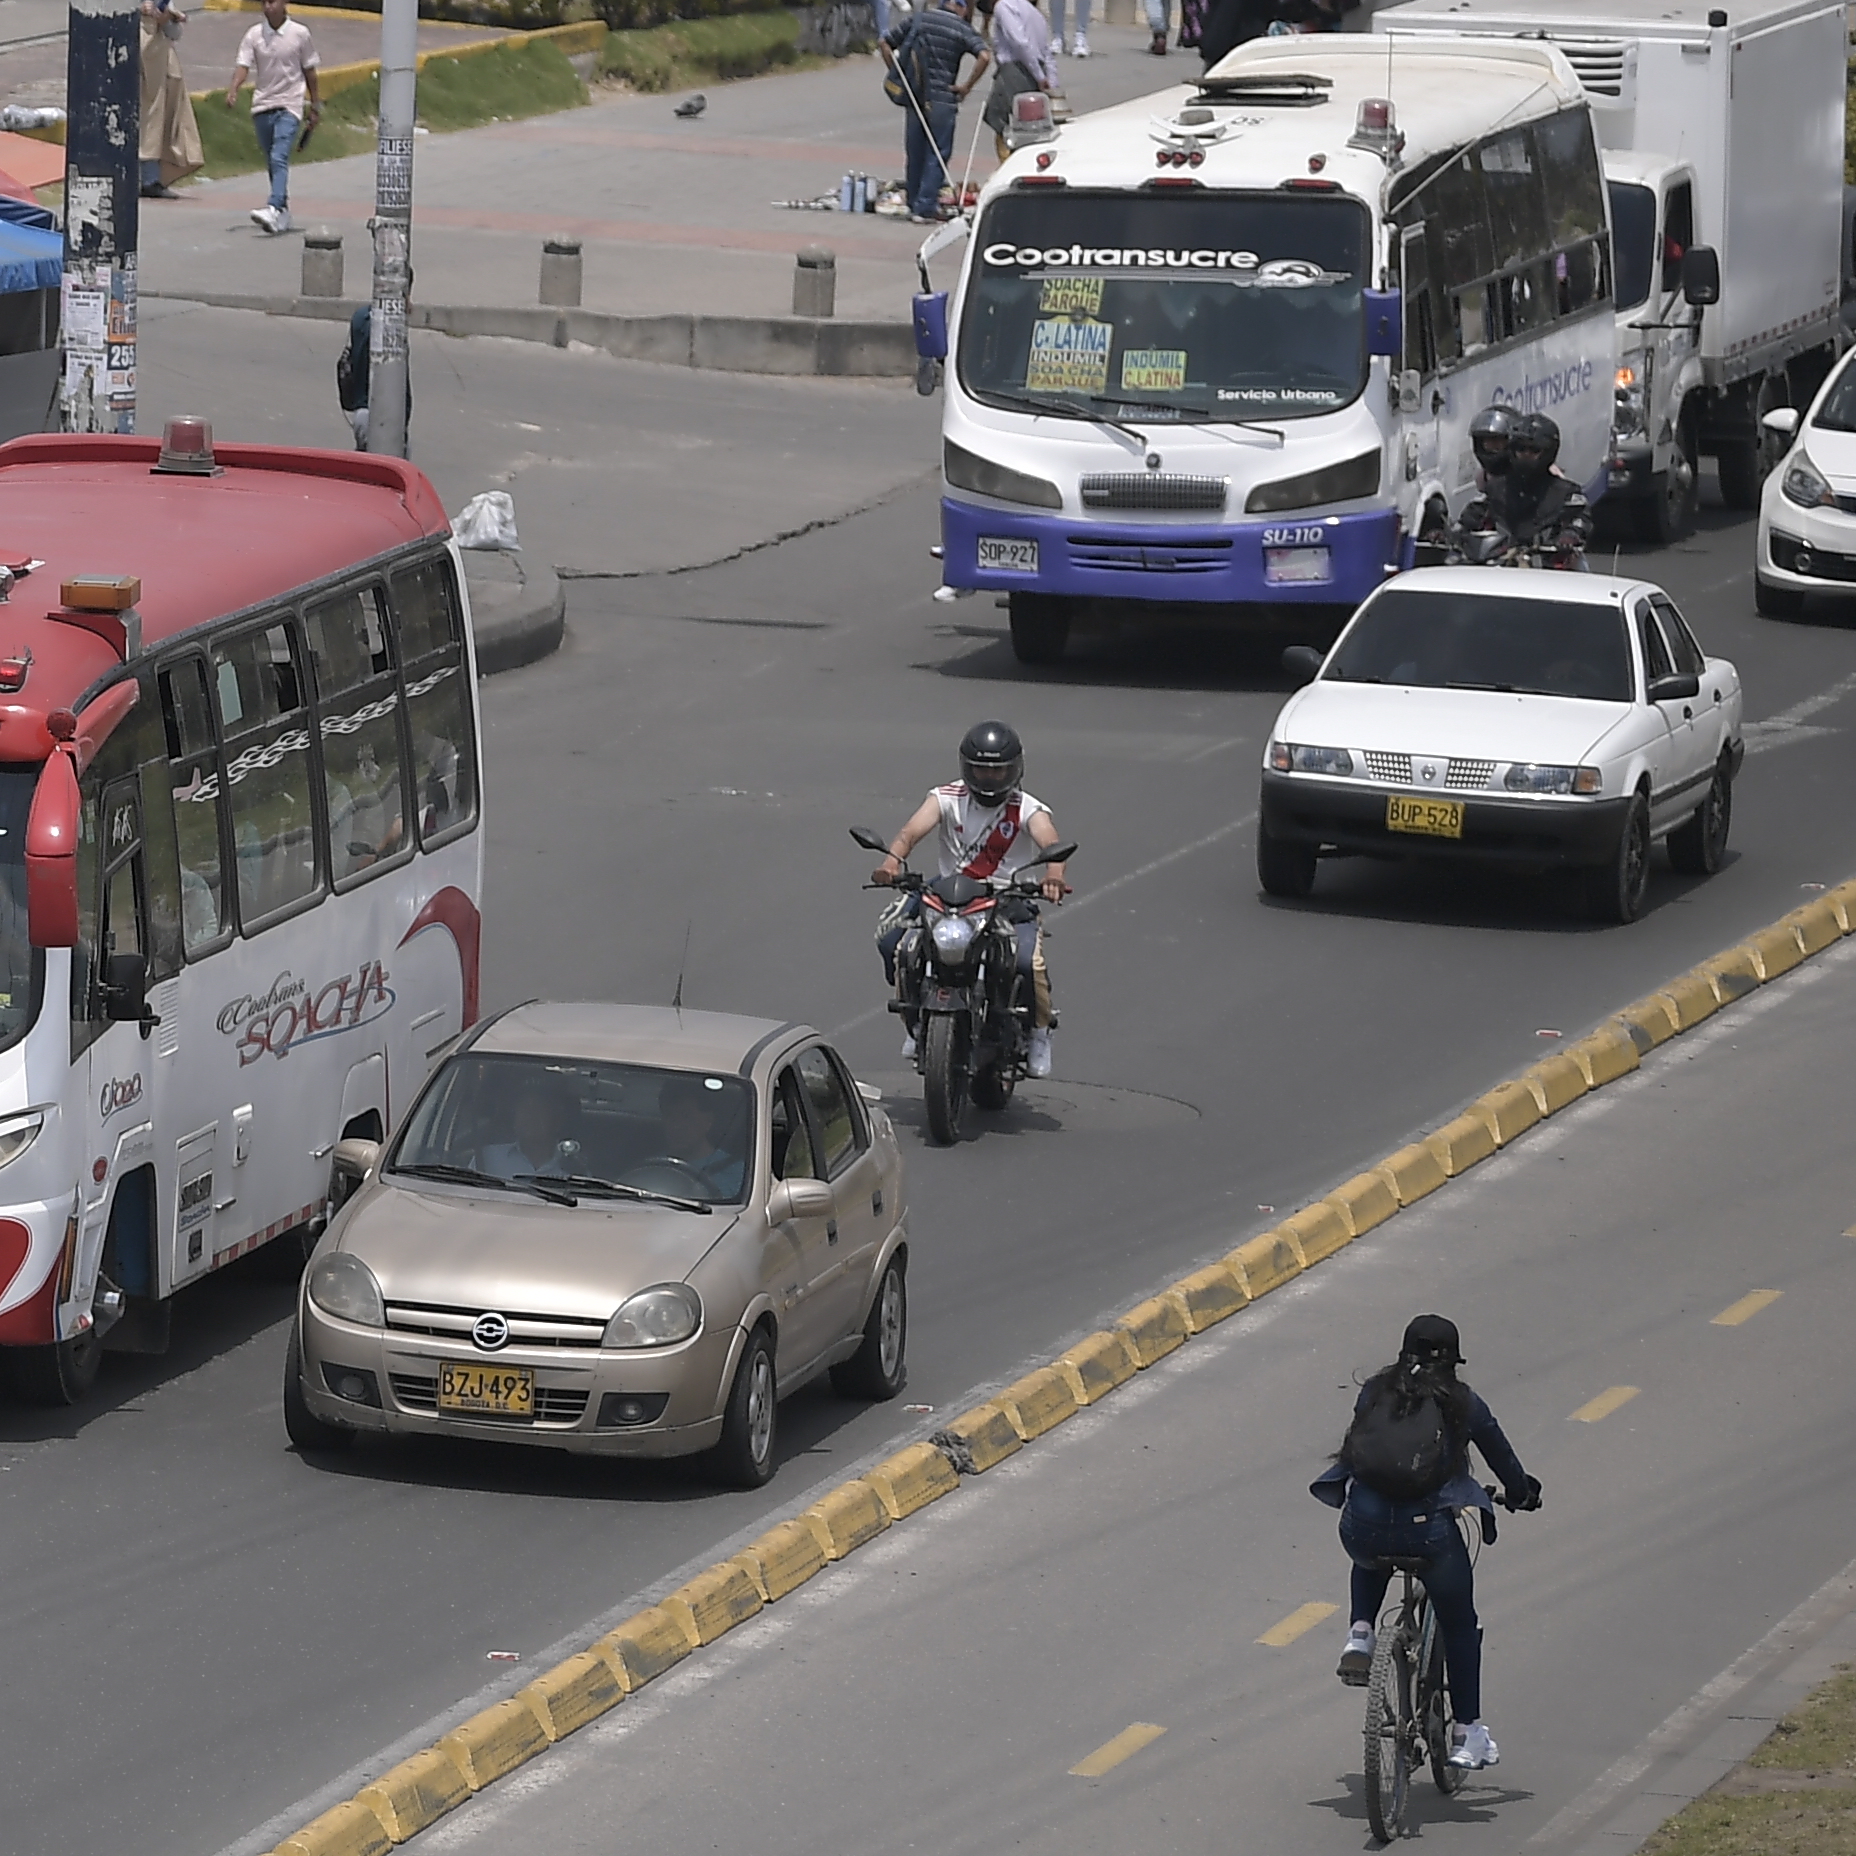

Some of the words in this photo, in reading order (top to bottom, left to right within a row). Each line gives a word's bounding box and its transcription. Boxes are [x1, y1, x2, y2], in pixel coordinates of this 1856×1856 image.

[982, 243, 1259, 269] Cootransucre
[1054, 325, 1107, 351] LATINA
[1032, 350, 1106, 365] INDUMIL
[1124, 350, 1183, 368] INDUMIL
[1136, 368, 1181, 388] LATINA
[1217, 388, 1277, 400] Servicio
[1280, 388, 1337, 400] Urbano
[1262, 526, 1323, 544] SU-110
[235, 960, 392, 1068] SOACHA
